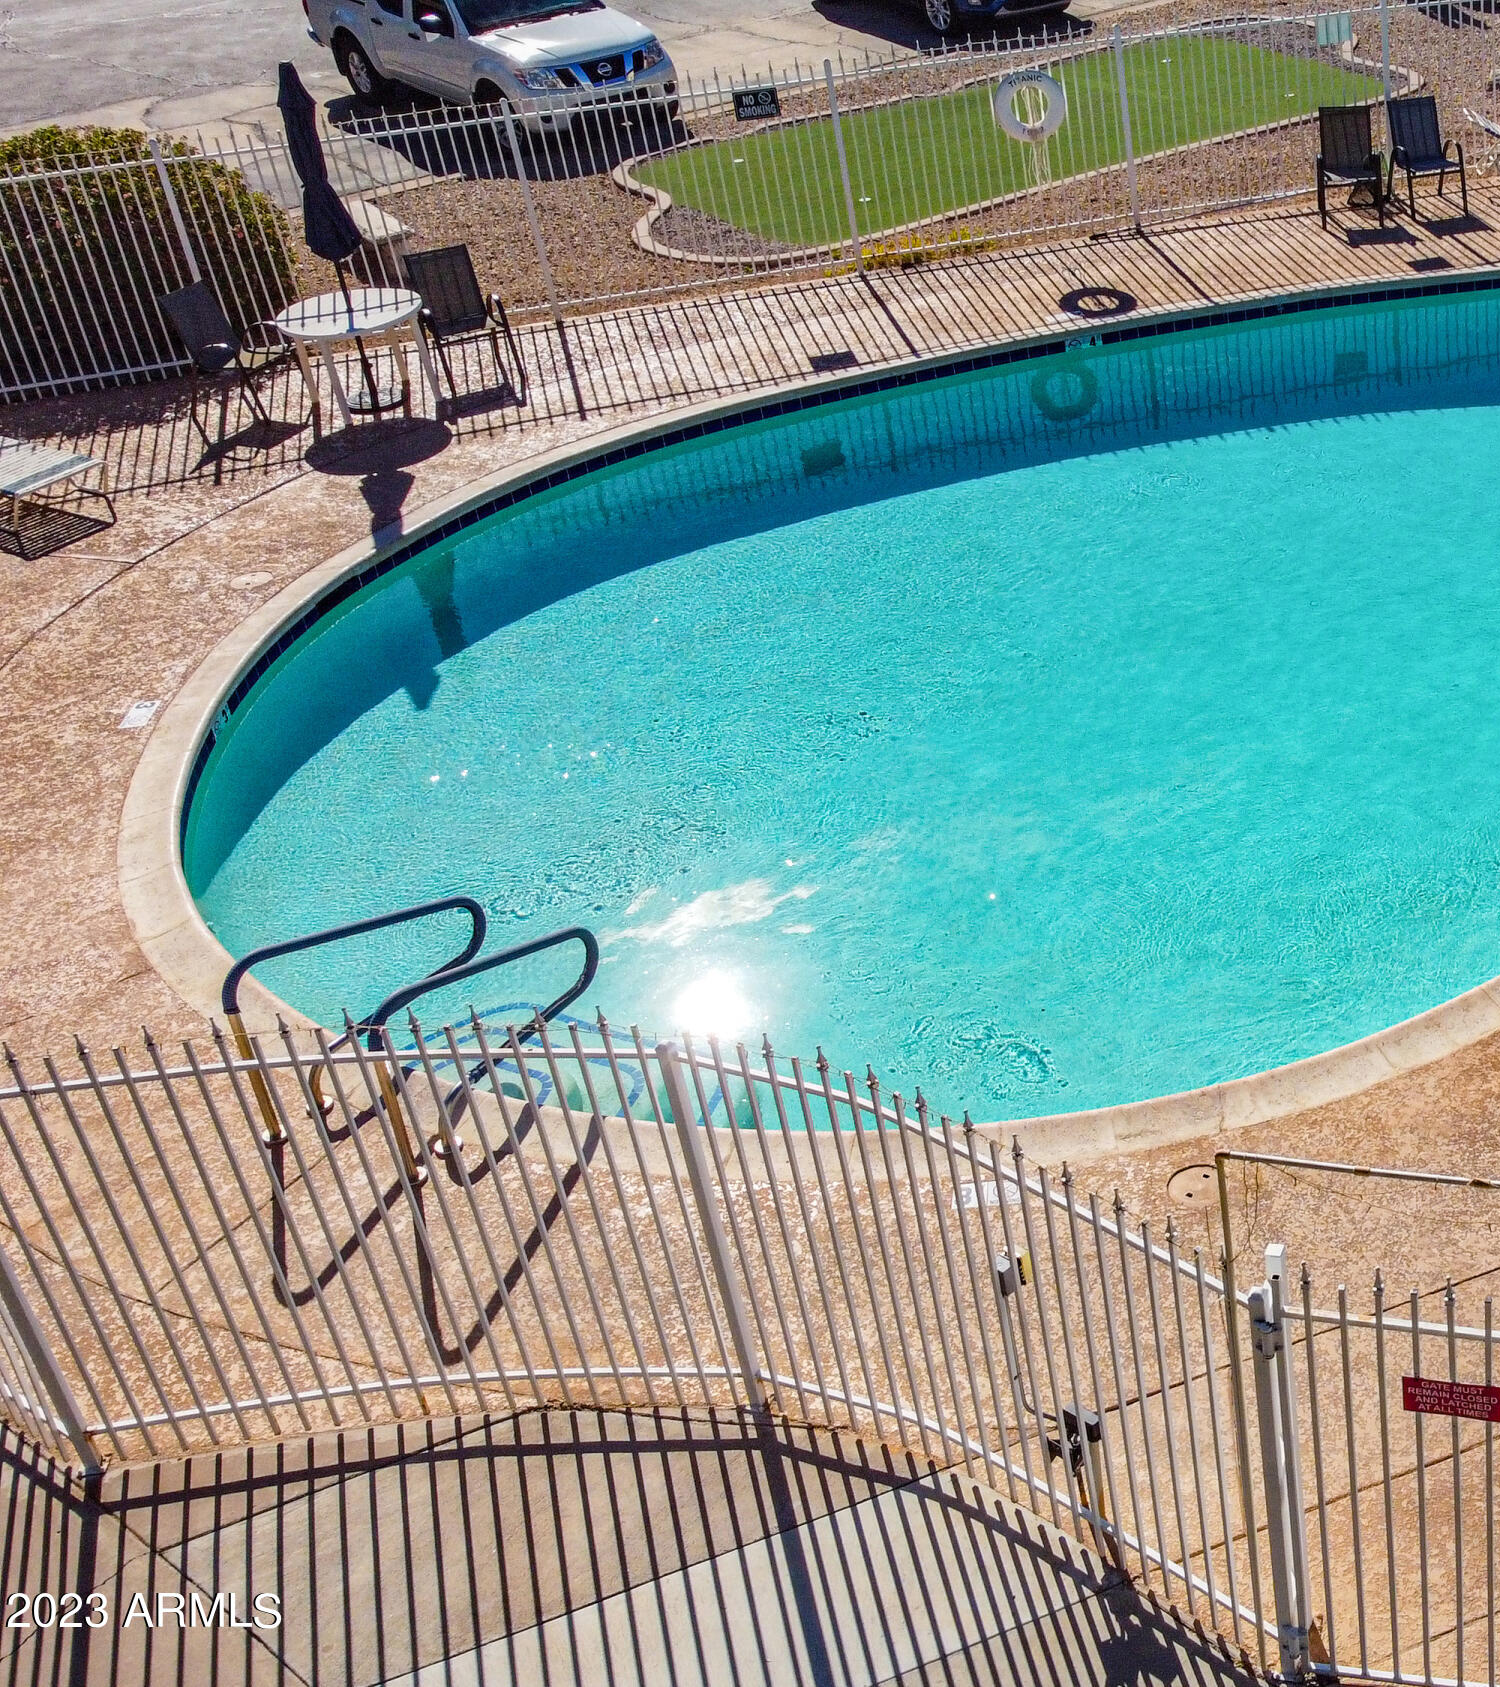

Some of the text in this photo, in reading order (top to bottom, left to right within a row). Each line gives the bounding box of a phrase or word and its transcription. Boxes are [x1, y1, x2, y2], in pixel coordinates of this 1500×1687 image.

[1008, 74, 1042, 88] TIANIC
[742, 95, 755, 106] NO
[739, 104, 776, 117] SMOKING
[1421, 1381, 1484, 1394] GATE MUST
[1407, 1386, 1498, 1404] REMAIN CLOSED
[1415, 1395, 1492, 1411] AND LATCHED
[1457, 1408, 1489, 1418] TIMES
